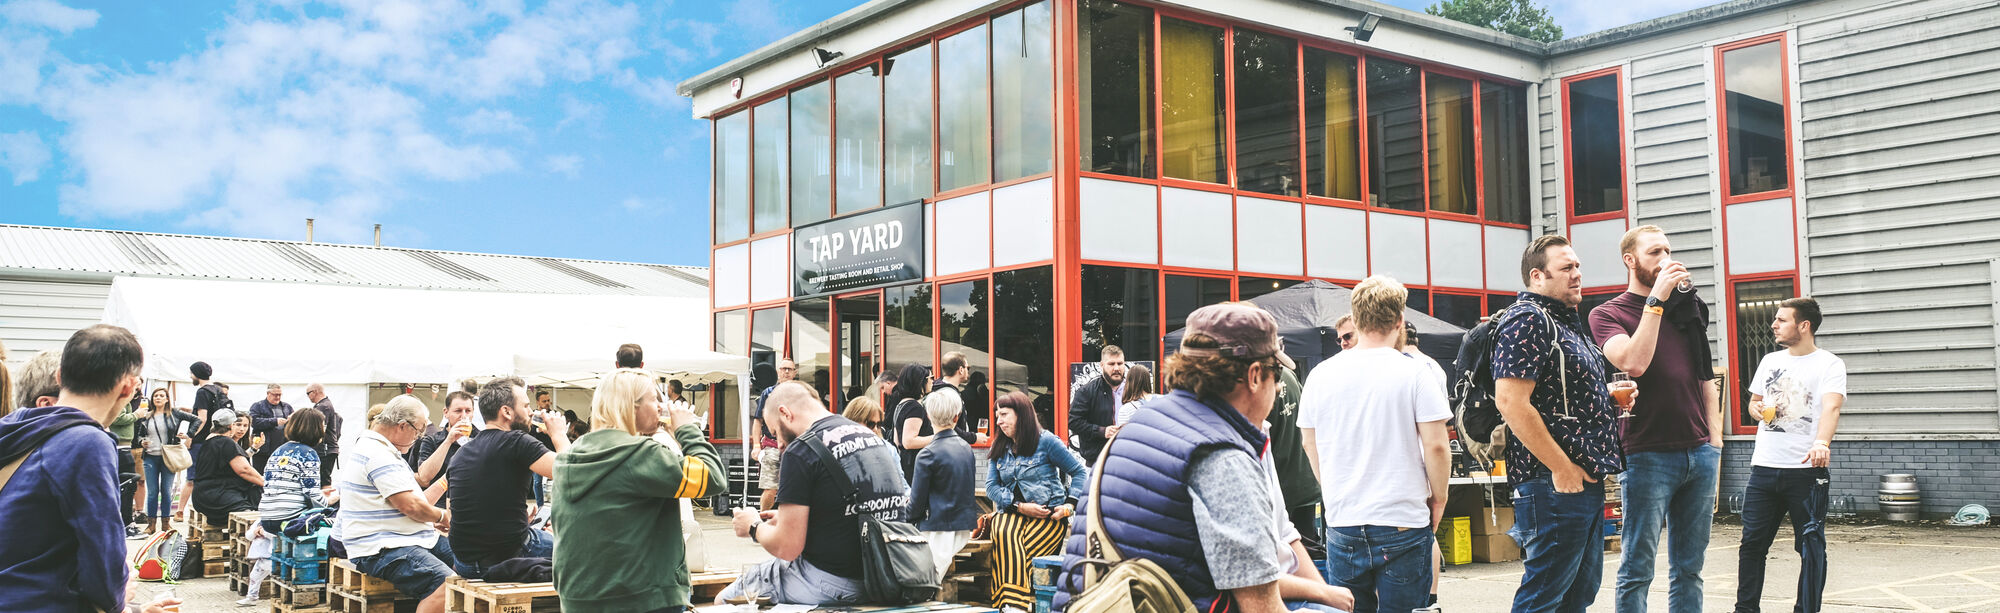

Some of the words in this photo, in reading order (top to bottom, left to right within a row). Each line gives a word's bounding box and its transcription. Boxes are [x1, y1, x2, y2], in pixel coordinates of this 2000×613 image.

[809, 232, 845, 263] TAP
[849, 220, 903, 256] YARD
[809, 275, 829, 284] BREWERY
[829, 272, 848, 281] TASTING
[848, 269, 863, 278] ROOM
[862, 268, 874, 276] AND
[873, 265, 891, 274] RETAIL
[890, 262, 905, 271] SHOP
[831, 436, 866, 461] FRIDAY
[845, 497, 890, 516] LODON
